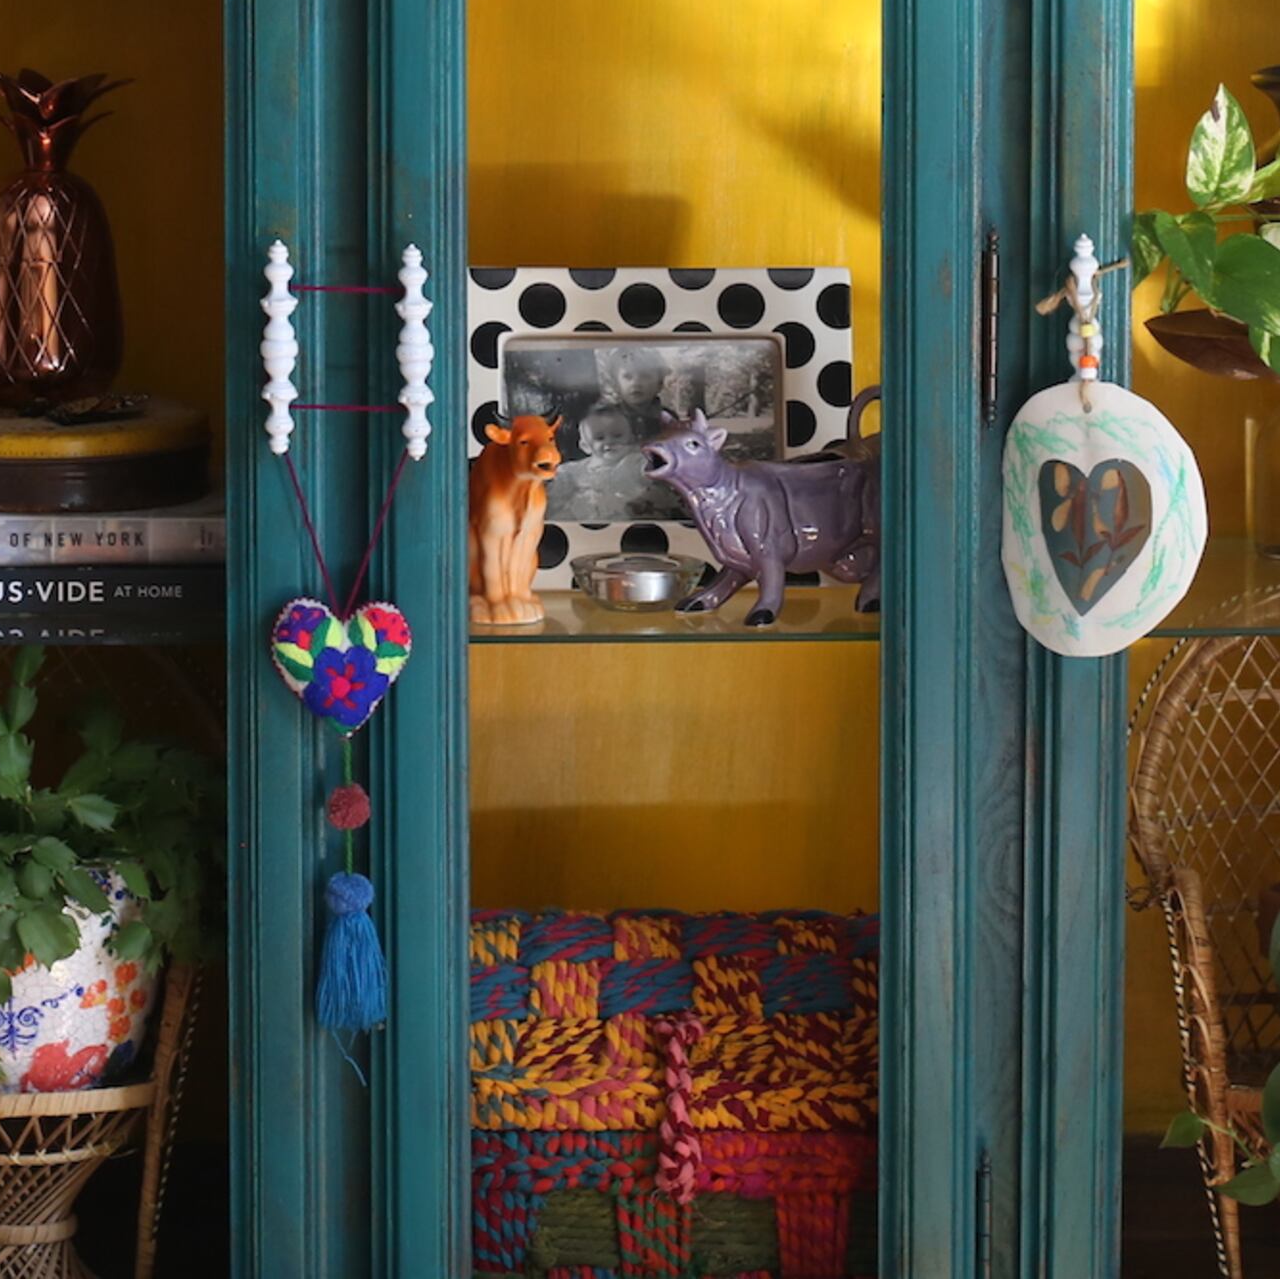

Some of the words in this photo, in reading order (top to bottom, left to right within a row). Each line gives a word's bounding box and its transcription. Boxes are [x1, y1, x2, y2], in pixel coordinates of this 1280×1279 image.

[9, 532, 31, 548] OF
[43, 532, 83, 547] NEW
[94, 531, 145, 546] YORK
[113, 585, 133, 599] AT
[137, 585, 183, 599] HOME
